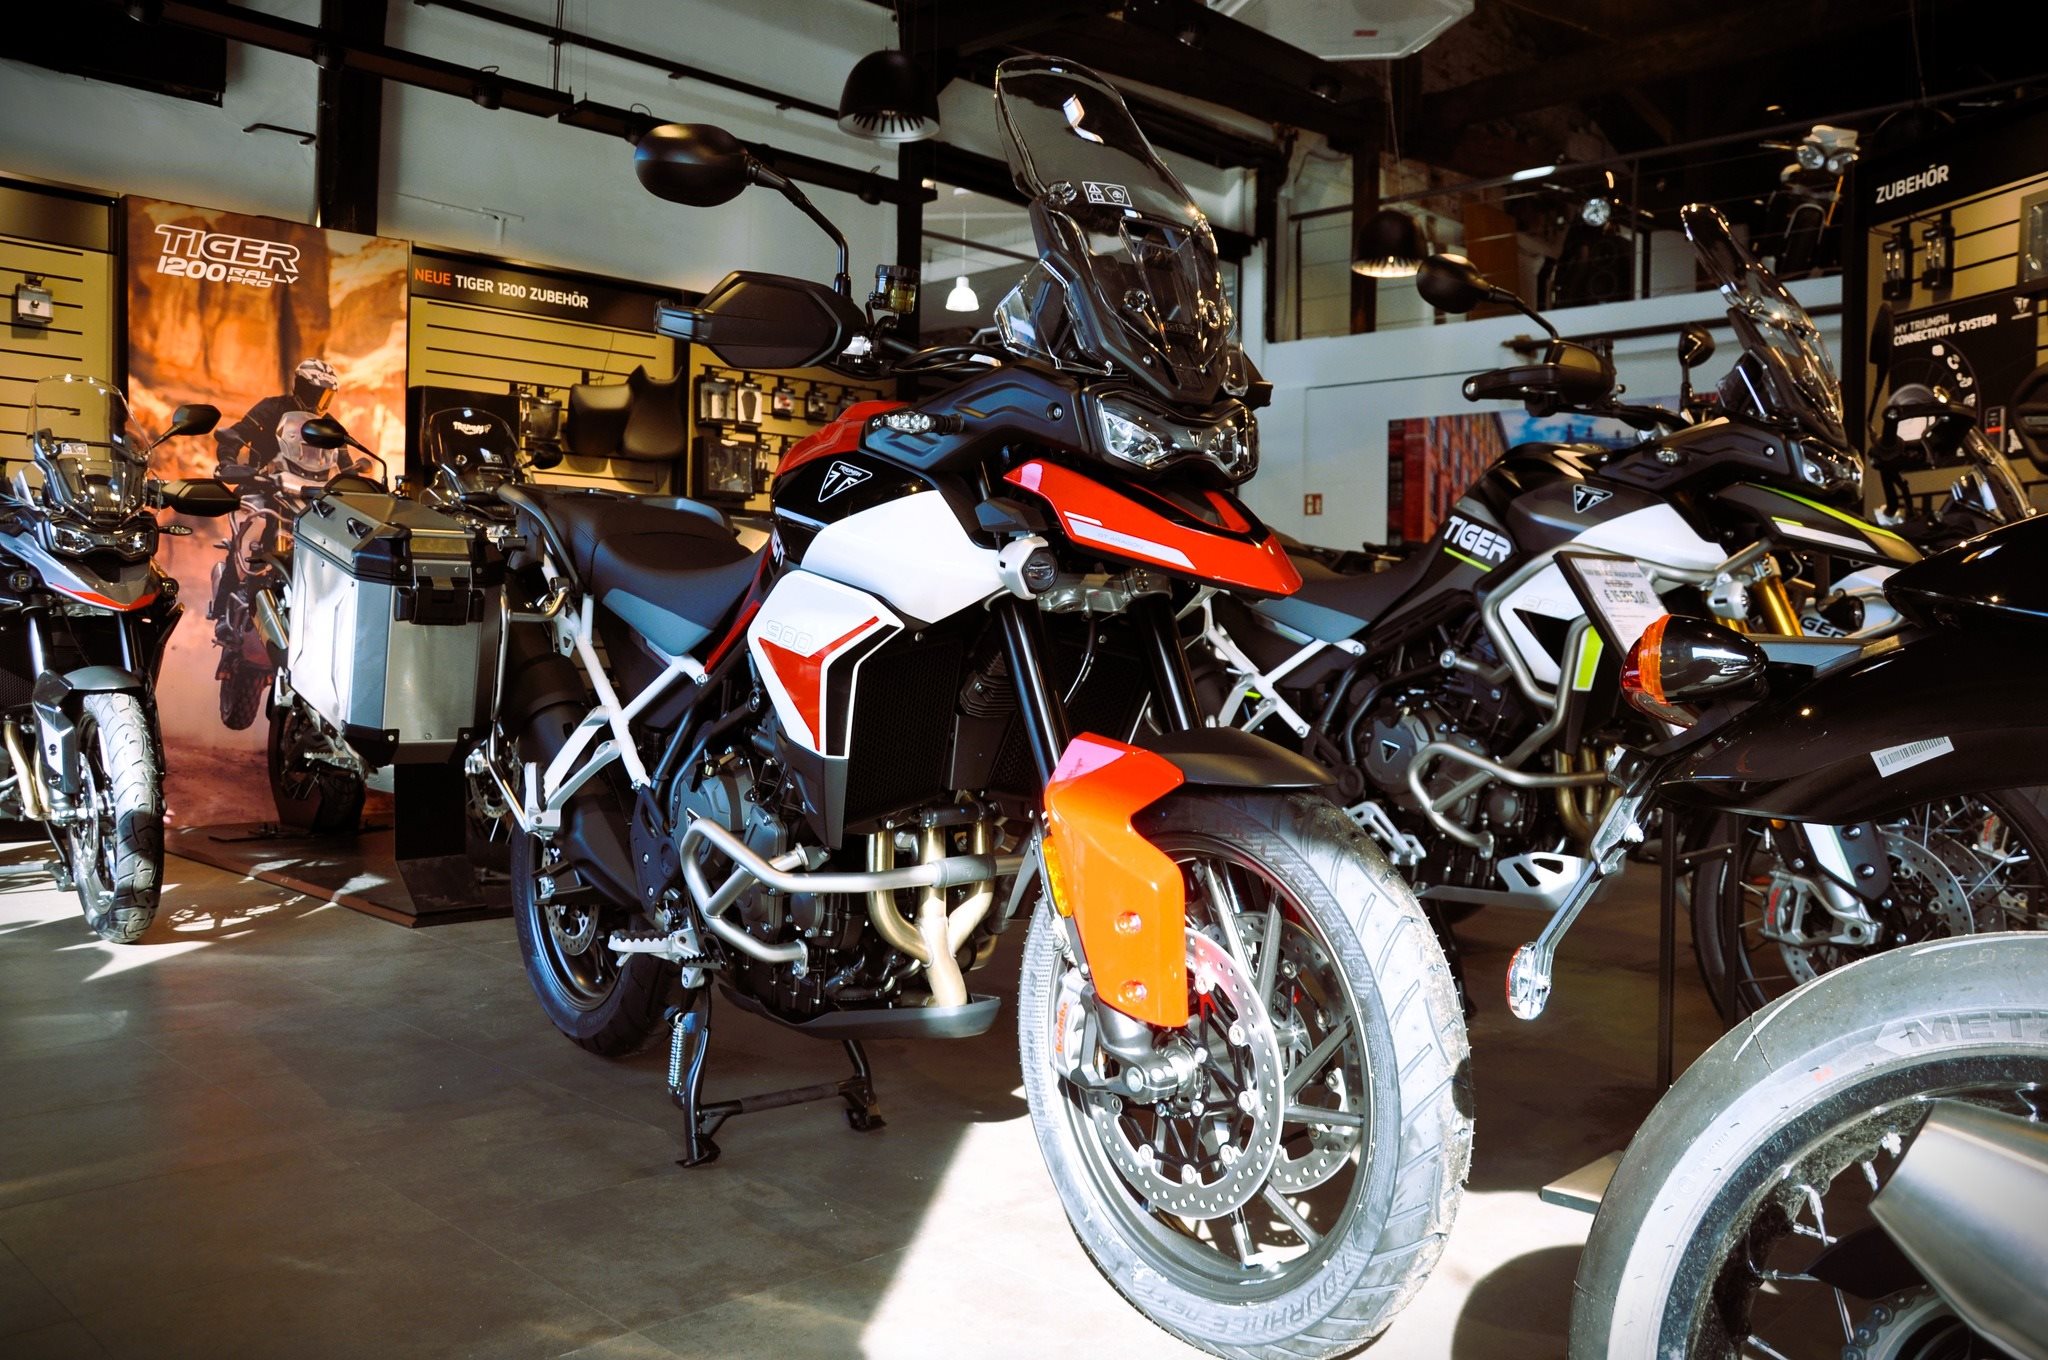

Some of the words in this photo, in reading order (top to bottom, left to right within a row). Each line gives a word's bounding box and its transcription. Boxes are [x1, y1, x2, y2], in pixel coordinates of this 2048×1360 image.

[1875, 163, 1949, 204] ZUBEHÖR
[154, 223, 301, 274] TIGER
[156, 255, 227, 282] 1200
[226, 275, 272, 288] PRO
[228, 266, 300, 284] RALLY
[414, 267, 451, 286] NEUE
[455, 274, 494, 294] TIGER
[497, 281, 527, 299] 1200
[529, 287, 589, 309] ZUBEHÖR
[1893, 323, 1957, 347] CONNECTIVITY
[1958, 313, 1998, 333] SYSTEM
[1910, 313, 1950, 331] TRIUMPH
[1443, 515, 1512, 563] TIGER
[765, 619, 814, 654] 900
[1800, 615, 1848, 638] GER
[1054, 1000, 1069, 1055] brembo
